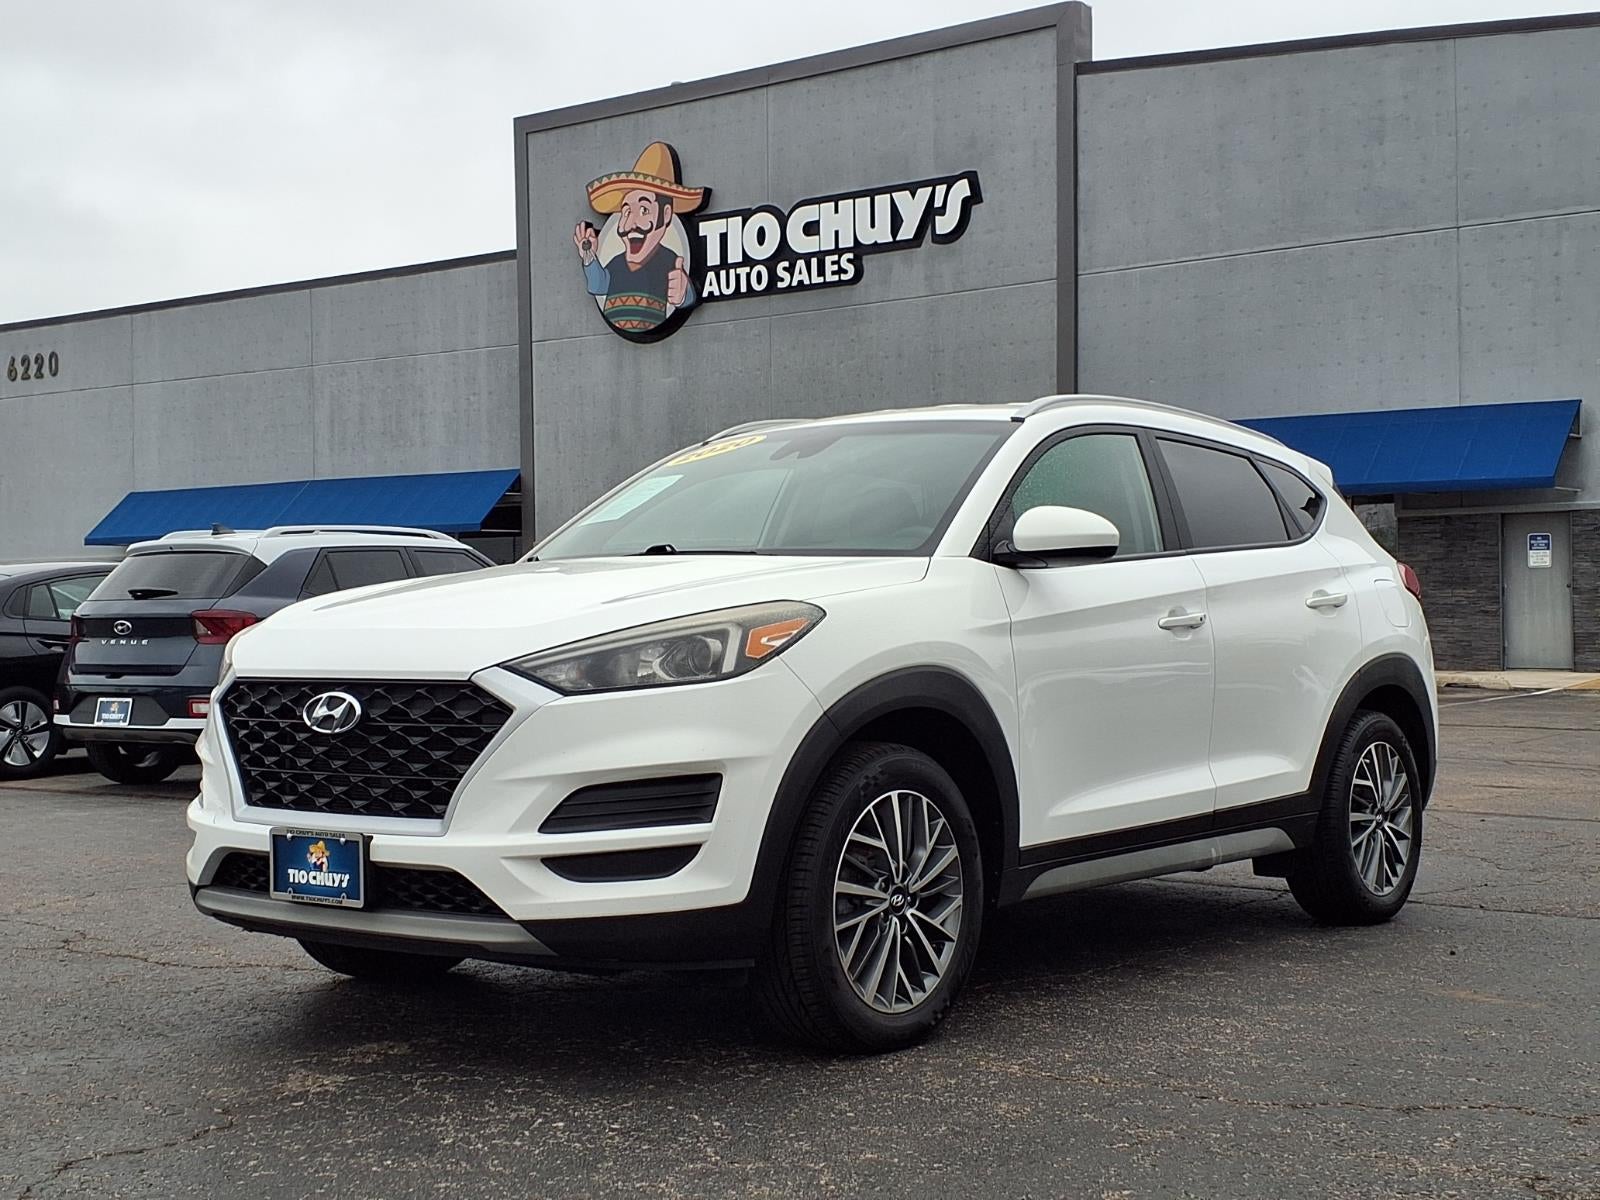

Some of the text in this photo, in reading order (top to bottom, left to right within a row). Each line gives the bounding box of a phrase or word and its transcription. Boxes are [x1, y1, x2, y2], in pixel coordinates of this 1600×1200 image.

[698, 177, 971, 267] TIO CHUY'S
[702, 252, 856, 297] AUTO SALES
[7, 351, 59, 382] 6220
[287, 868, 350, 888] TIO CHUY'S
